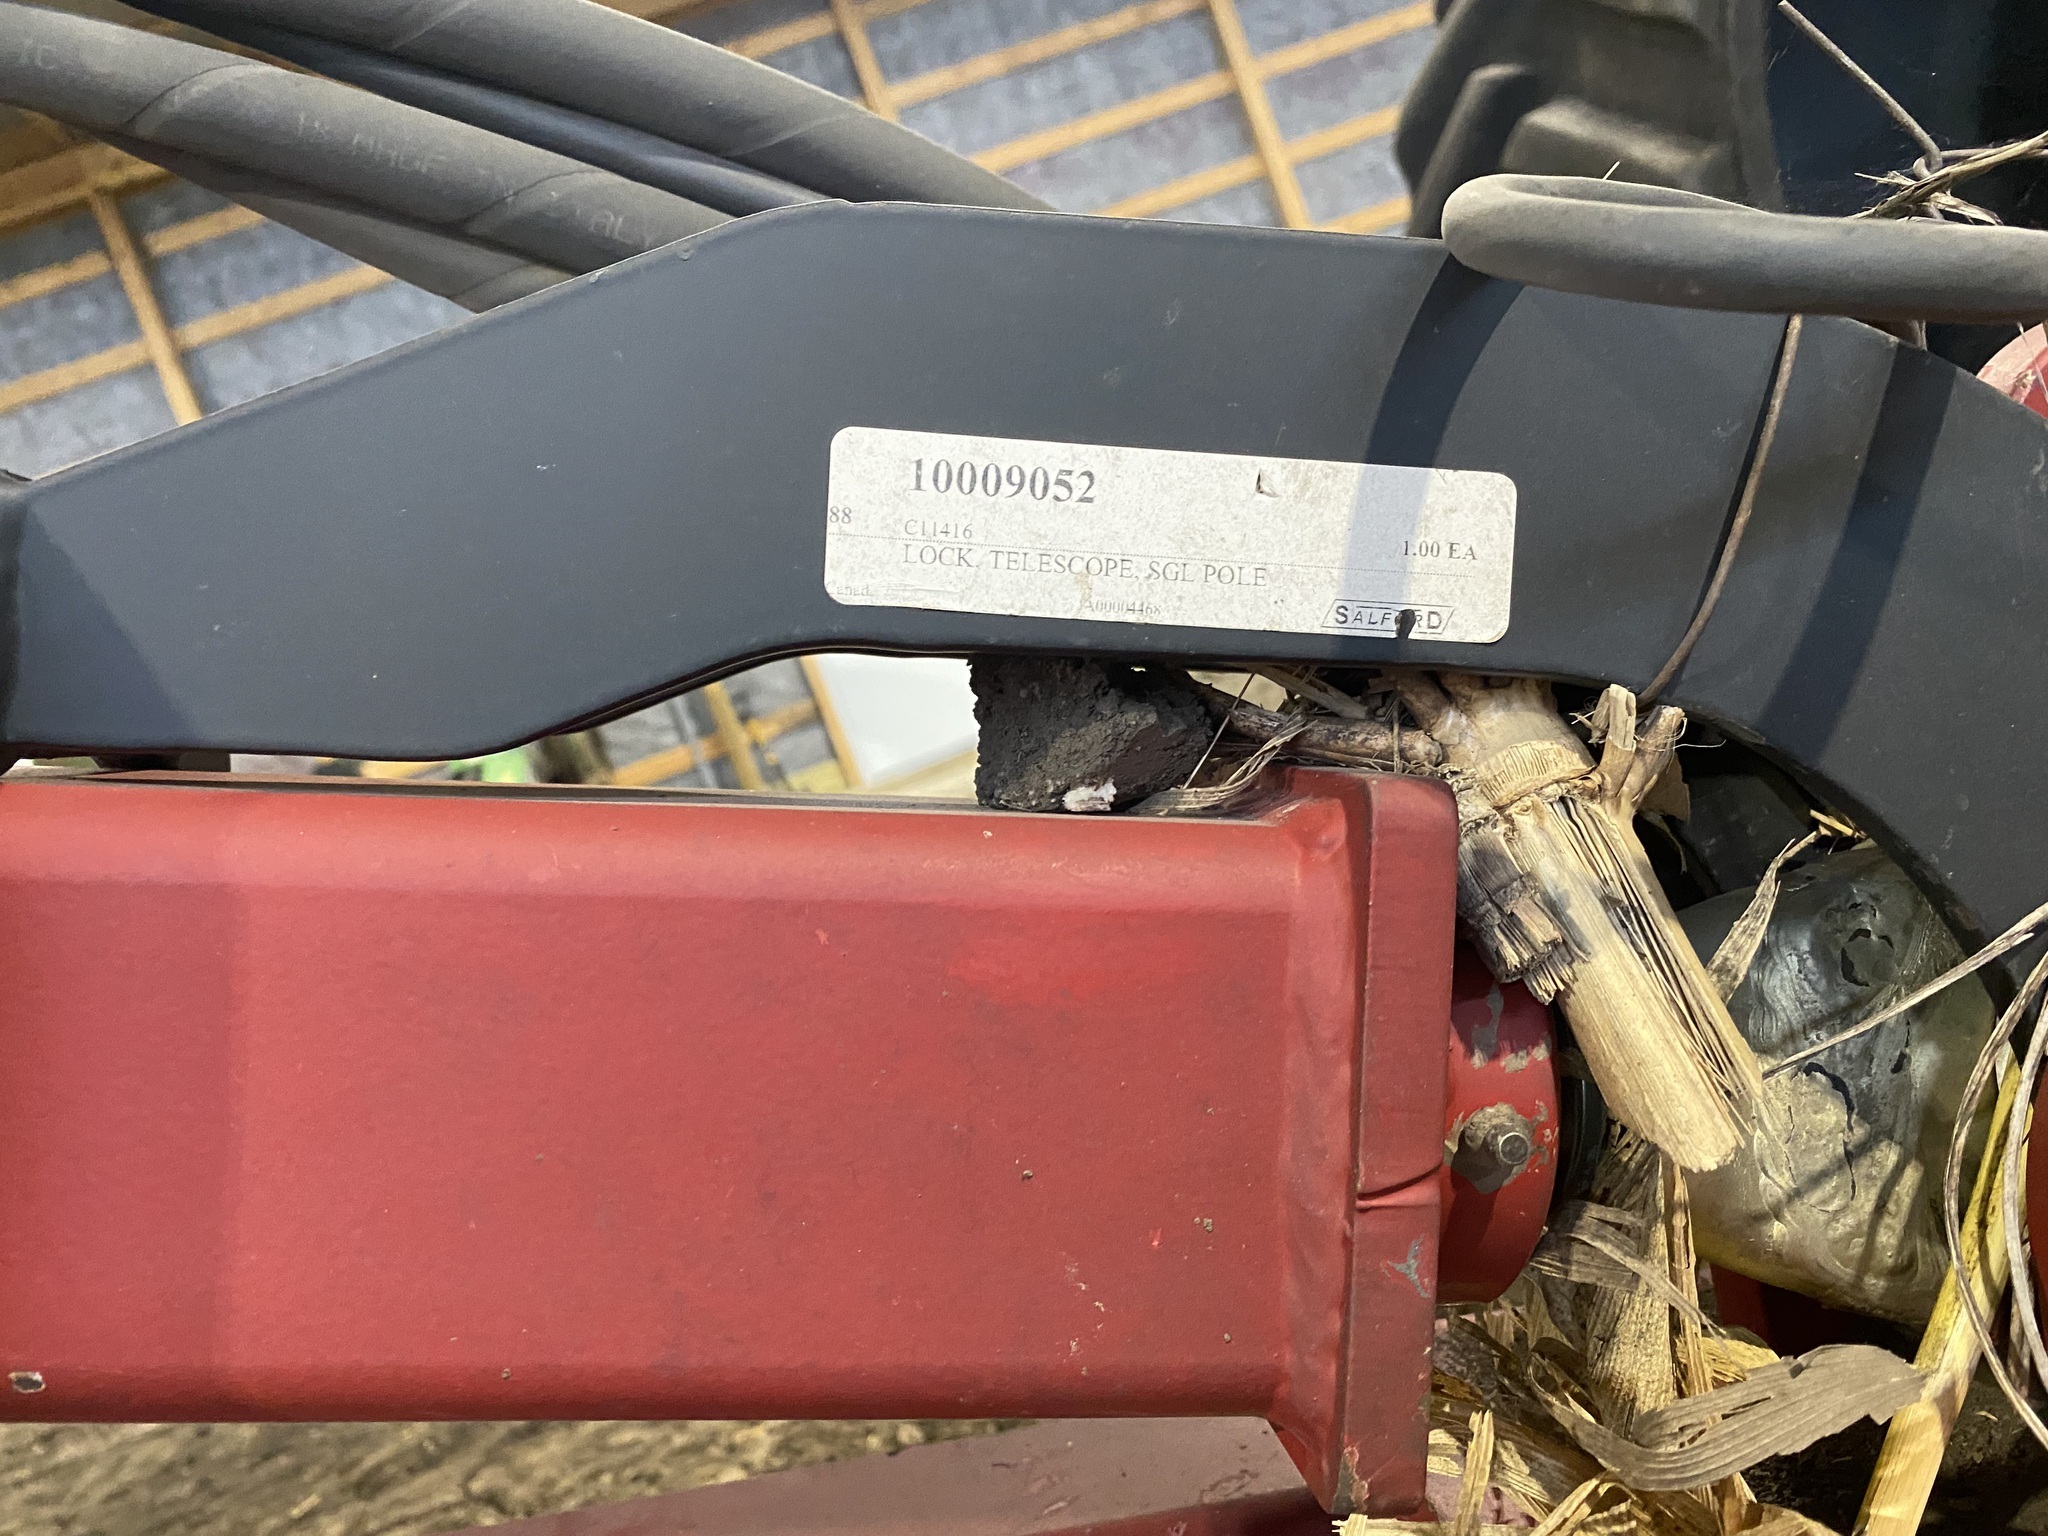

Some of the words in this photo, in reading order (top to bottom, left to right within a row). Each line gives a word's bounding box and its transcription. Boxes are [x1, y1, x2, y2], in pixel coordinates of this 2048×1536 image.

[909, 457, 1096, 504] 10009052
[904, 518, 973, 539] C11416
[1403, 540, 1440, 558] 1.00
[1448, 542, 1477, 561] EA
[990, 550, 1140, 581] TELESCOPE,
[1148, 560, 1195, 583] SGL
[1203, 564, 1267, 587] POLE
[1335, 605, 1442, 630] SALFRD
